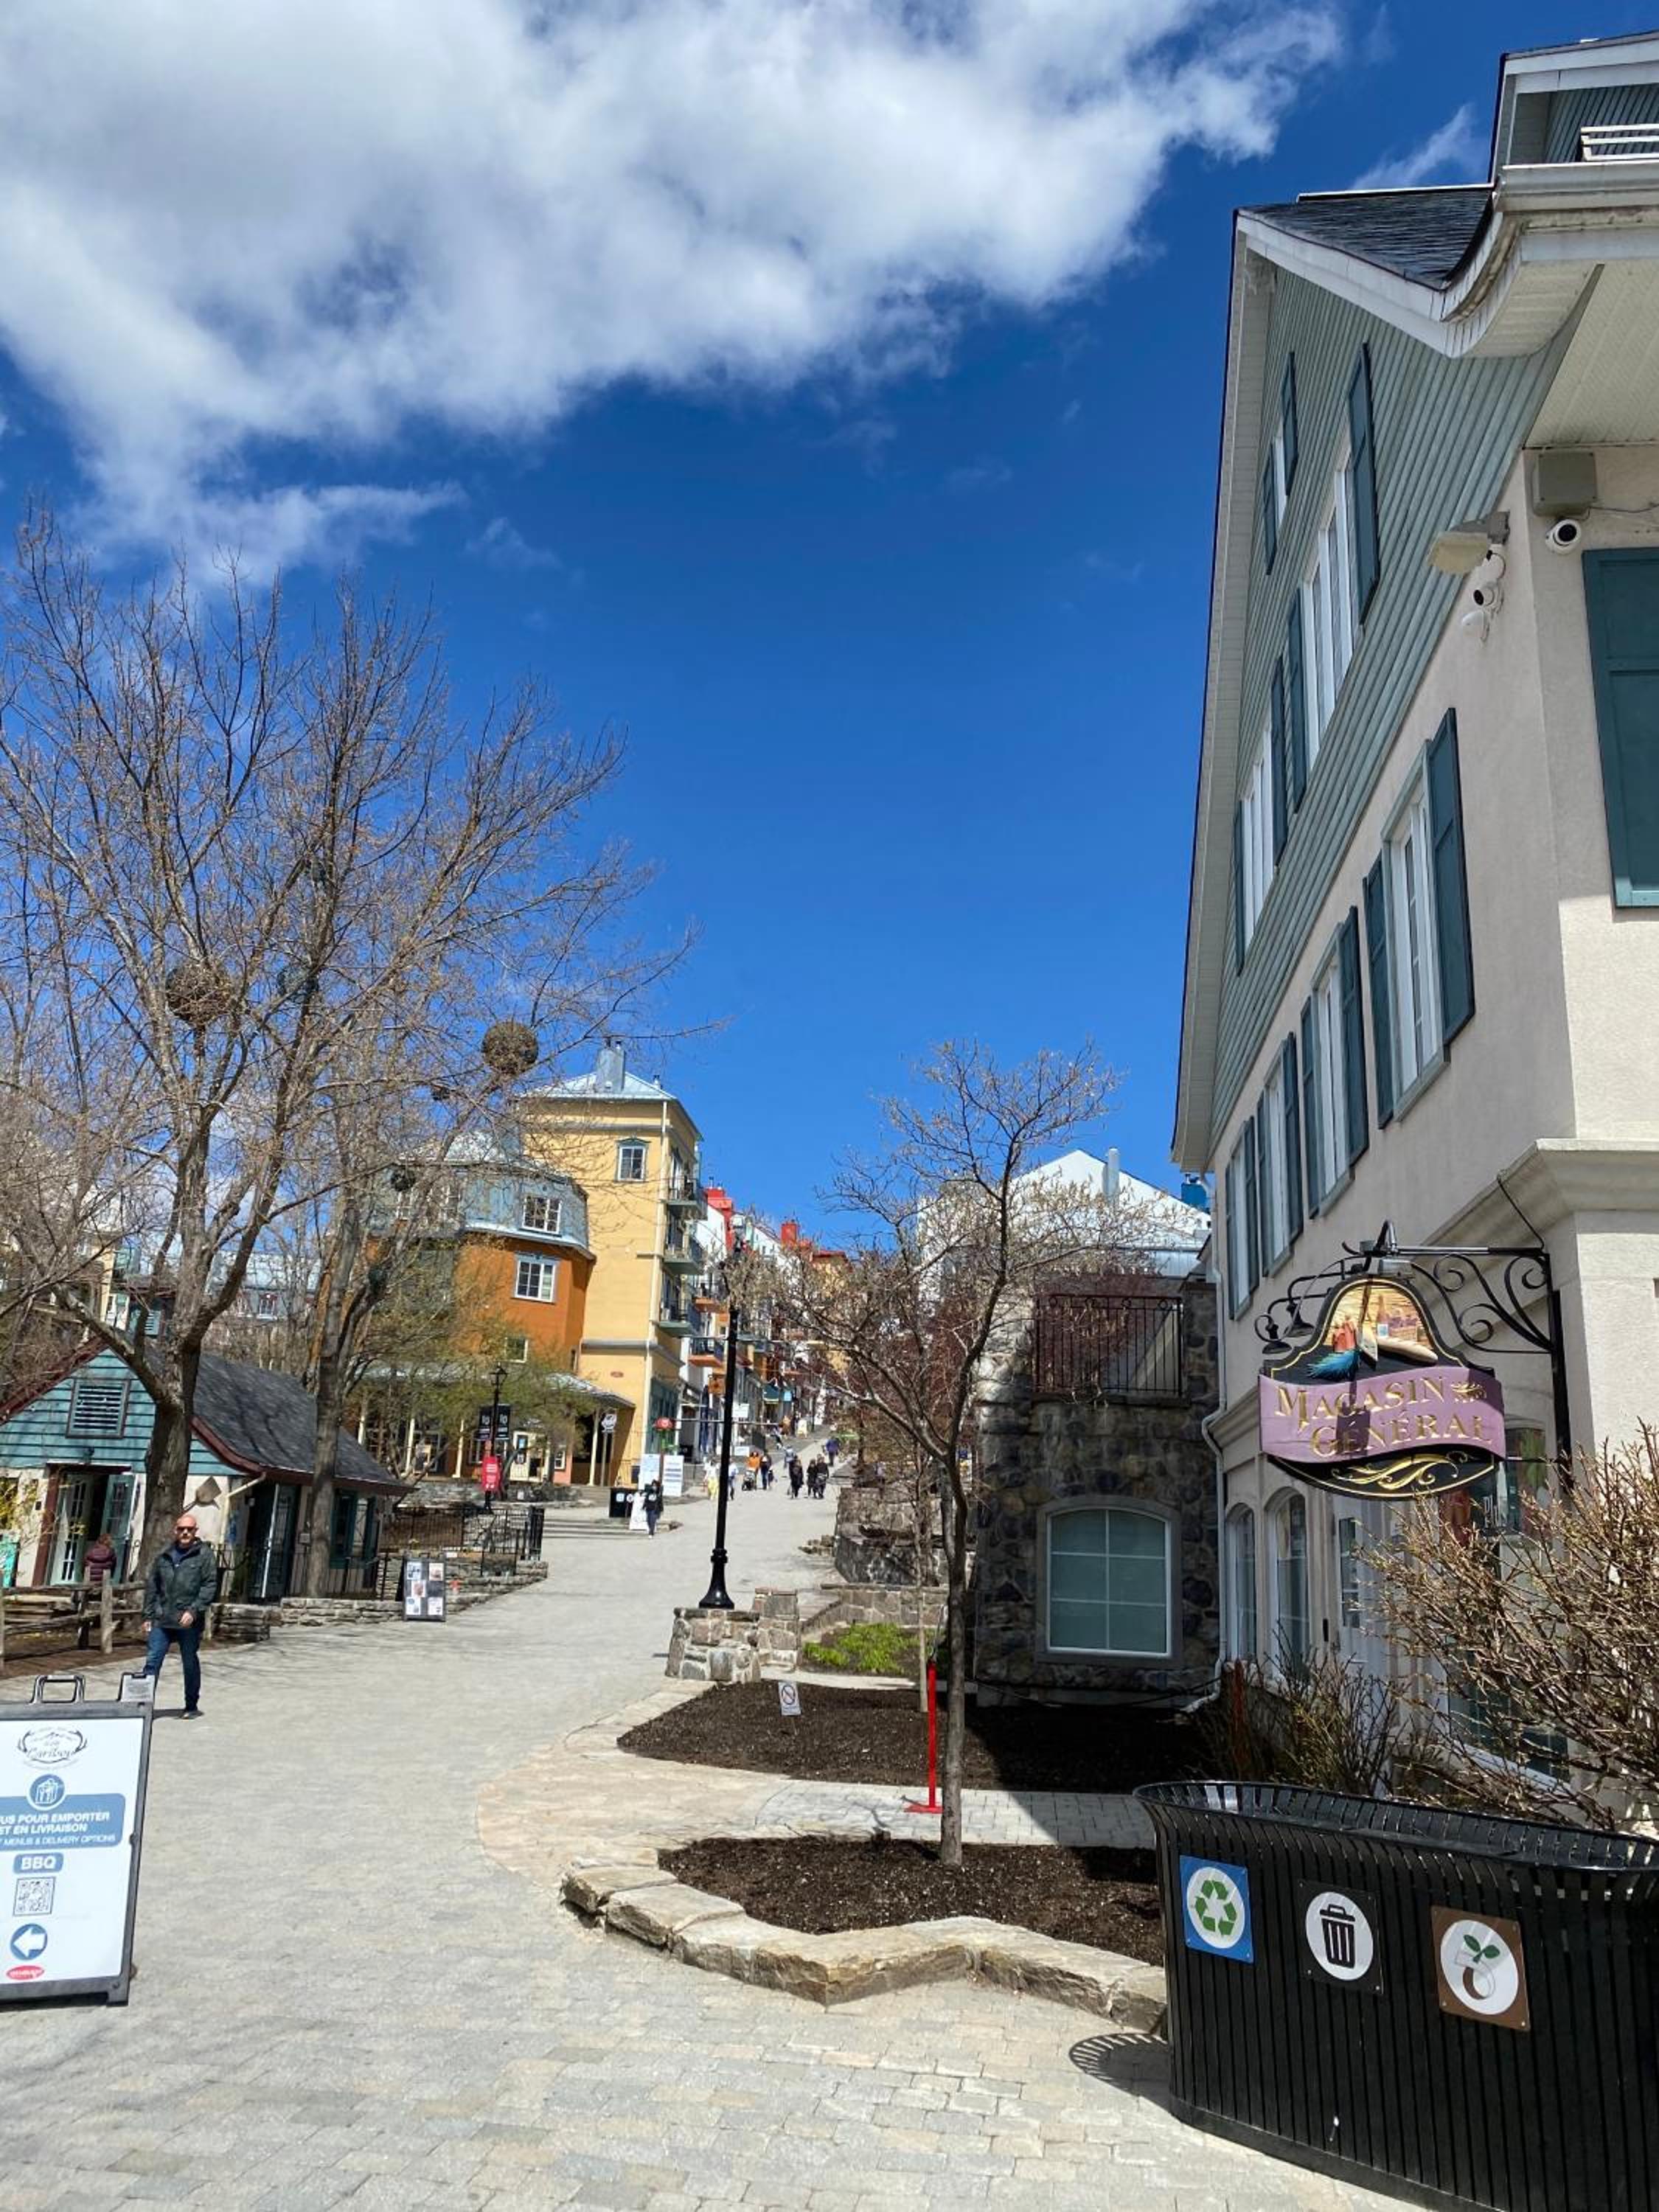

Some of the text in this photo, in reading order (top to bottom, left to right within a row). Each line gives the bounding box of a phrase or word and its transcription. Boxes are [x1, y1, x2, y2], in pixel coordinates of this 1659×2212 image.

[1274, 1377, 1446, 1430] MAGASIN
[1310, 1409, 1493, 1458] GÉNÉRAL
[18, 1814, 48, 1824] POUR
[51, 1811, 110, 1823] EMPORTER
[13, 1825, 29, 1834] EN
[31, 1823, 88, 1834] LIVRAISON
[42, 1835, 79, 1844] DELIVERY
[81, 1833, 116, 1842] OPTIONS
[21, 1856, 56, 1870] BBQ
